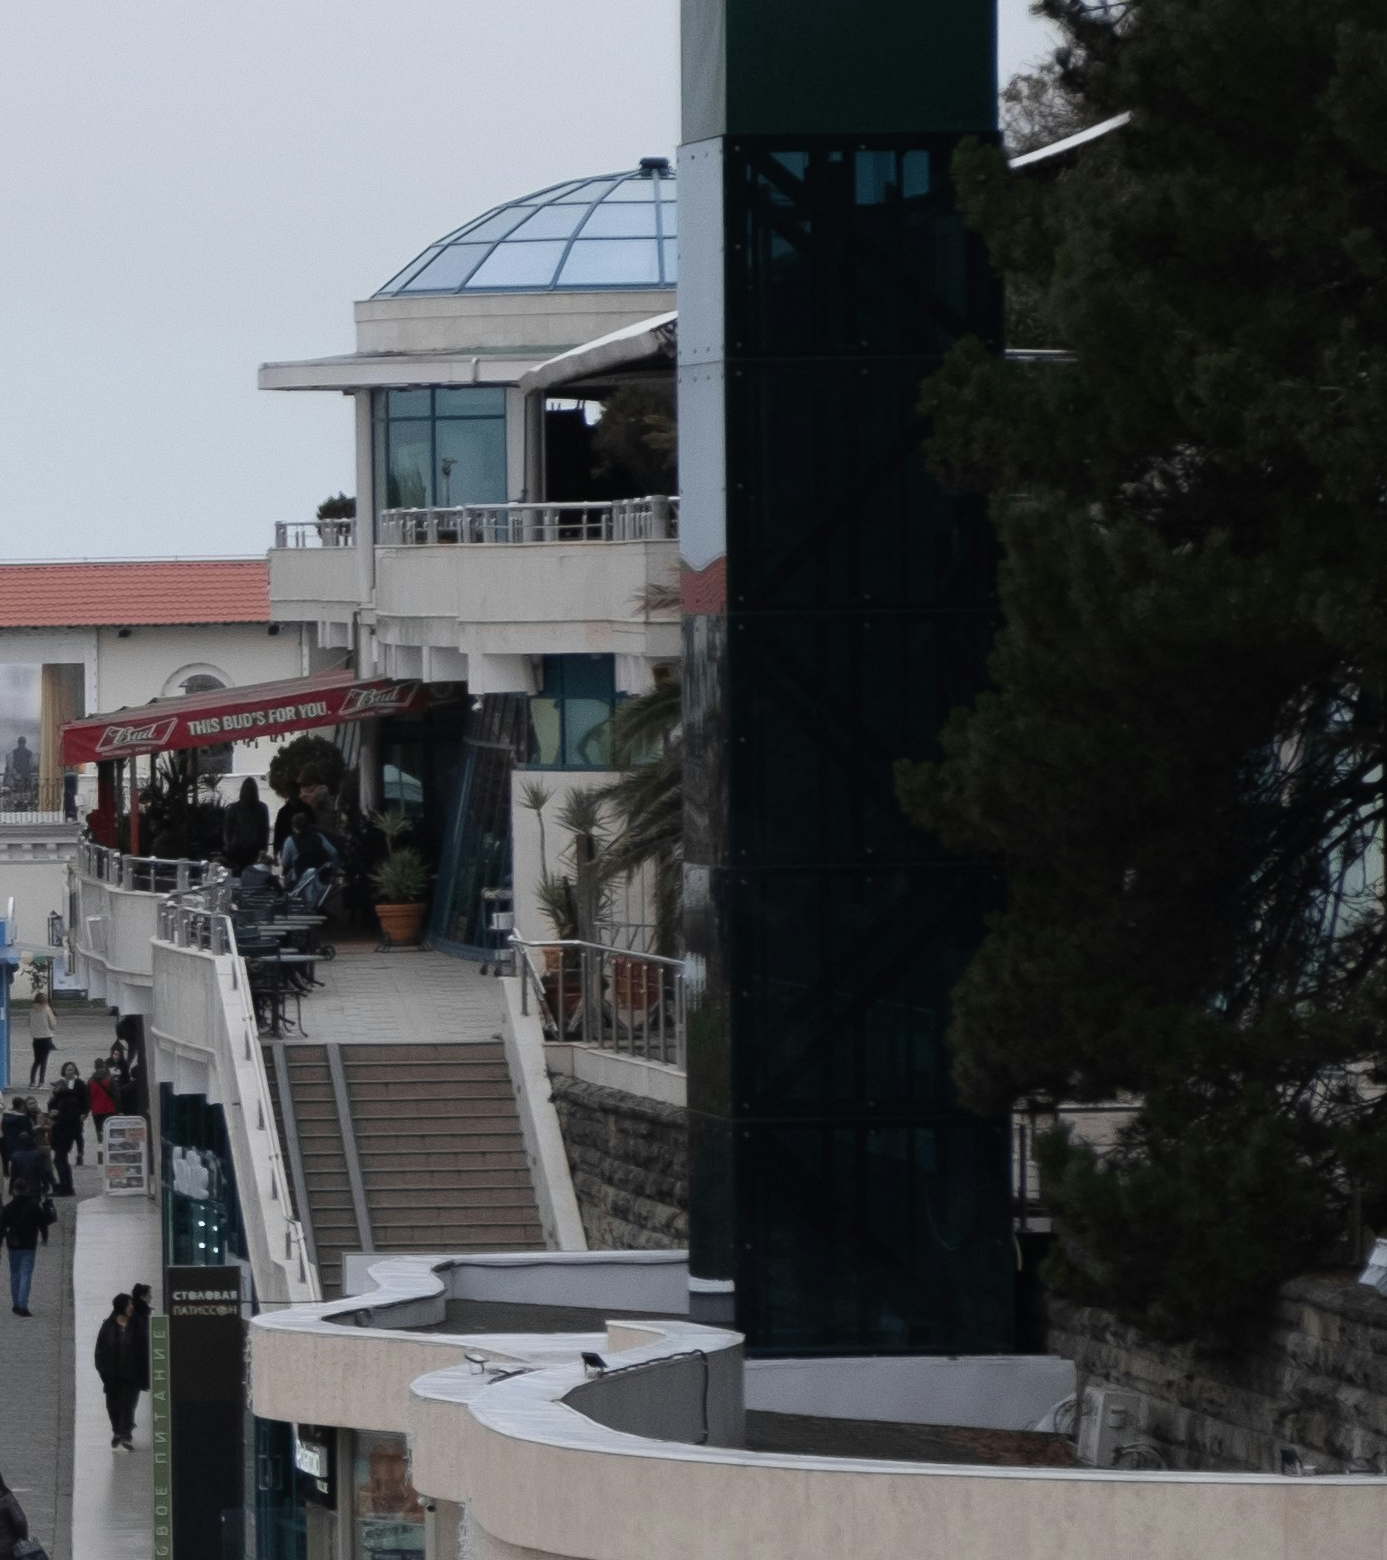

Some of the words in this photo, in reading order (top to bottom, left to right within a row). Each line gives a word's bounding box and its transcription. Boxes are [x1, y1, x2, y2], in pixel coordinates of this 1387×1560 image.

[187, 717, 221, 736] THIS
[222, 711, 266, 731] BUD'S
[268, 706, 296, 724] FOR
[172, 1290, 238, 1301] СТОЛОВАЯ
[154, 1329, 168, 1464] ПИТАНИЕ
